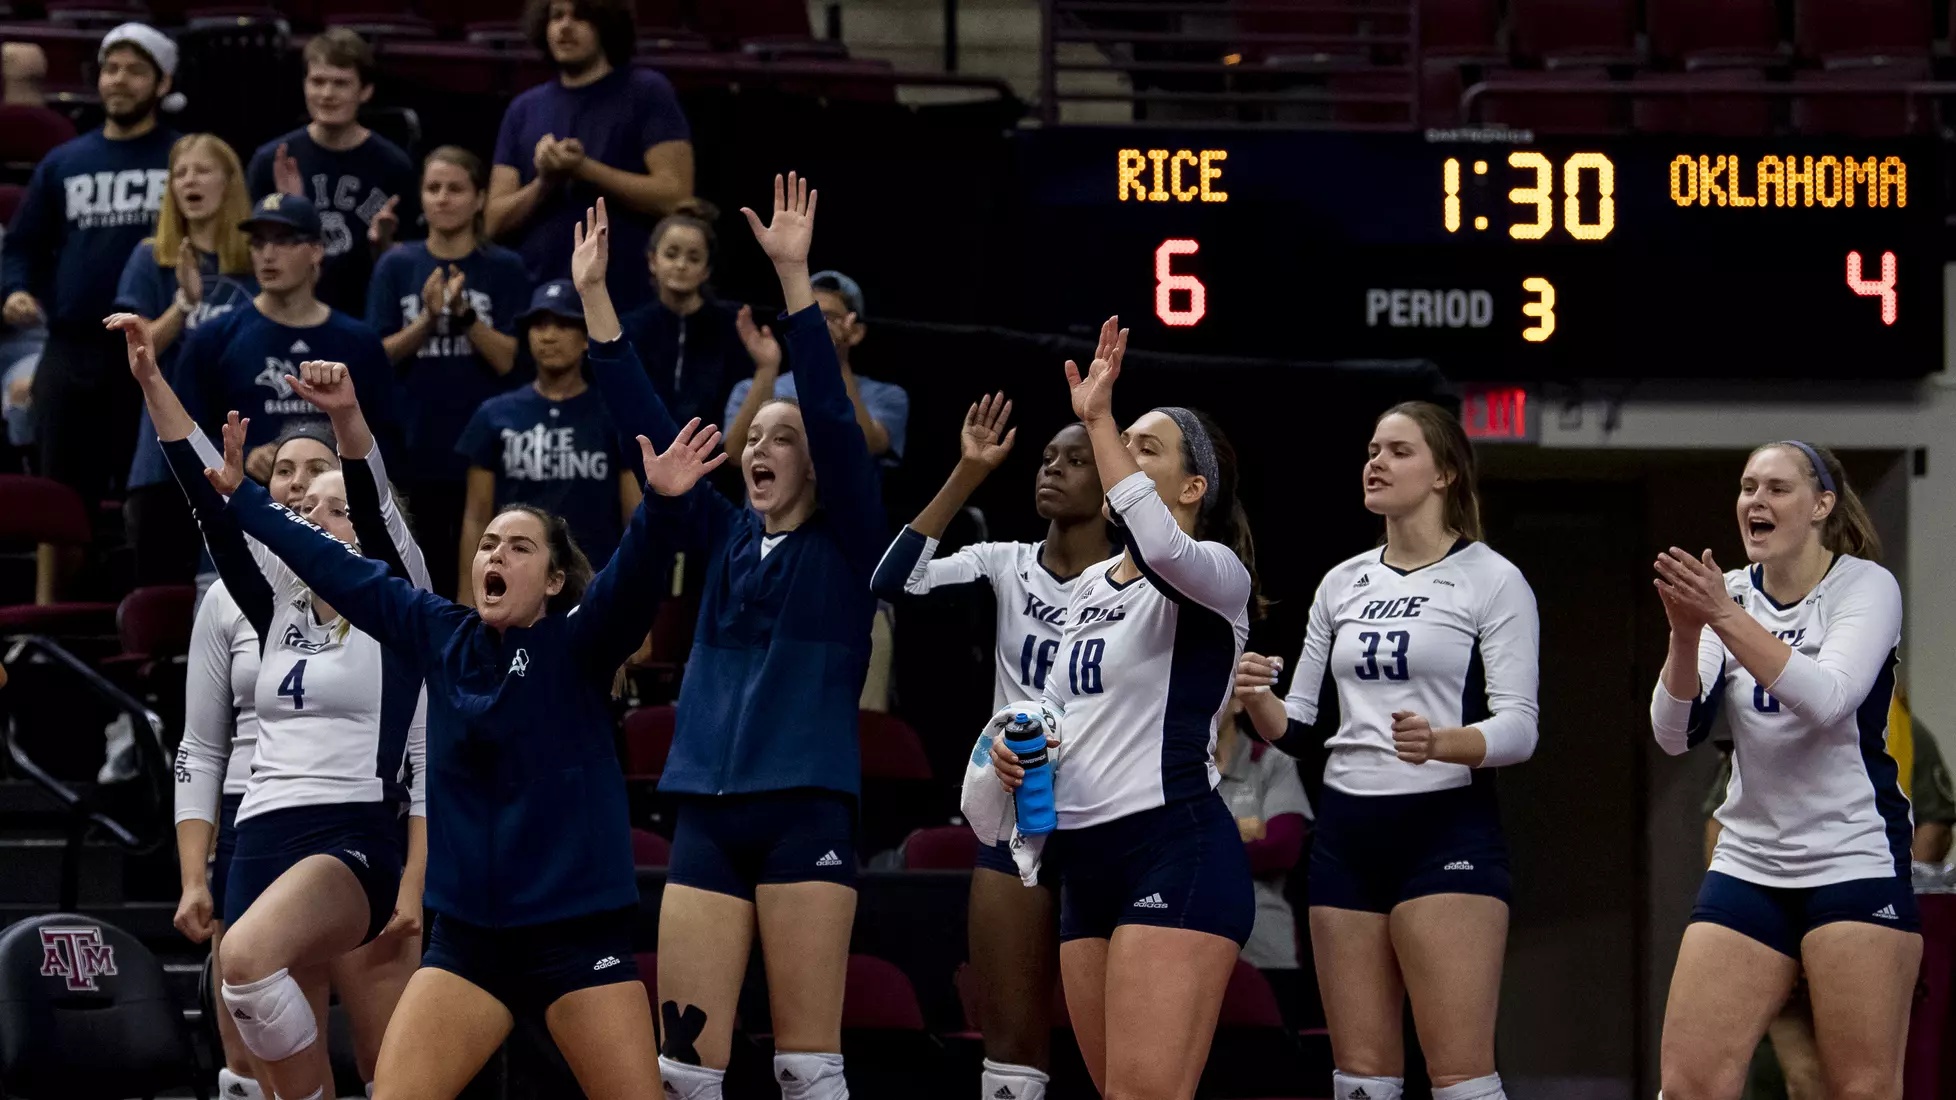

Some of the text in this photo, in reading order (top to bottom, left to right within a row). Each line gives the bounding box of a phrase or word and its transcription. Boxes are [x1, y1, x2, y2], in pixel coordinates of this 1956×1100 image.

[63, 168, 171, 222] RICE
[311, 173, 388, 225] ICE
[1118, 149, 1228, 202] RICE
[1443, 151, 1615, 240] 1:30
[1669, 154, 1907, 208] OKLAHOMA
[1155, 239, 1206, 327] 6
[1365, 277, 1556, 342] PERIOD 3
[1846, 251, 1896, 325] 4
[1023, 591, 1068, 626] RIC
[1358, 596, 1430, 619] RICE
[1068, 637, 1106, 695] 18
[1354, 630, 1410, 681] 33
[277, 658, 308, 710] 4
